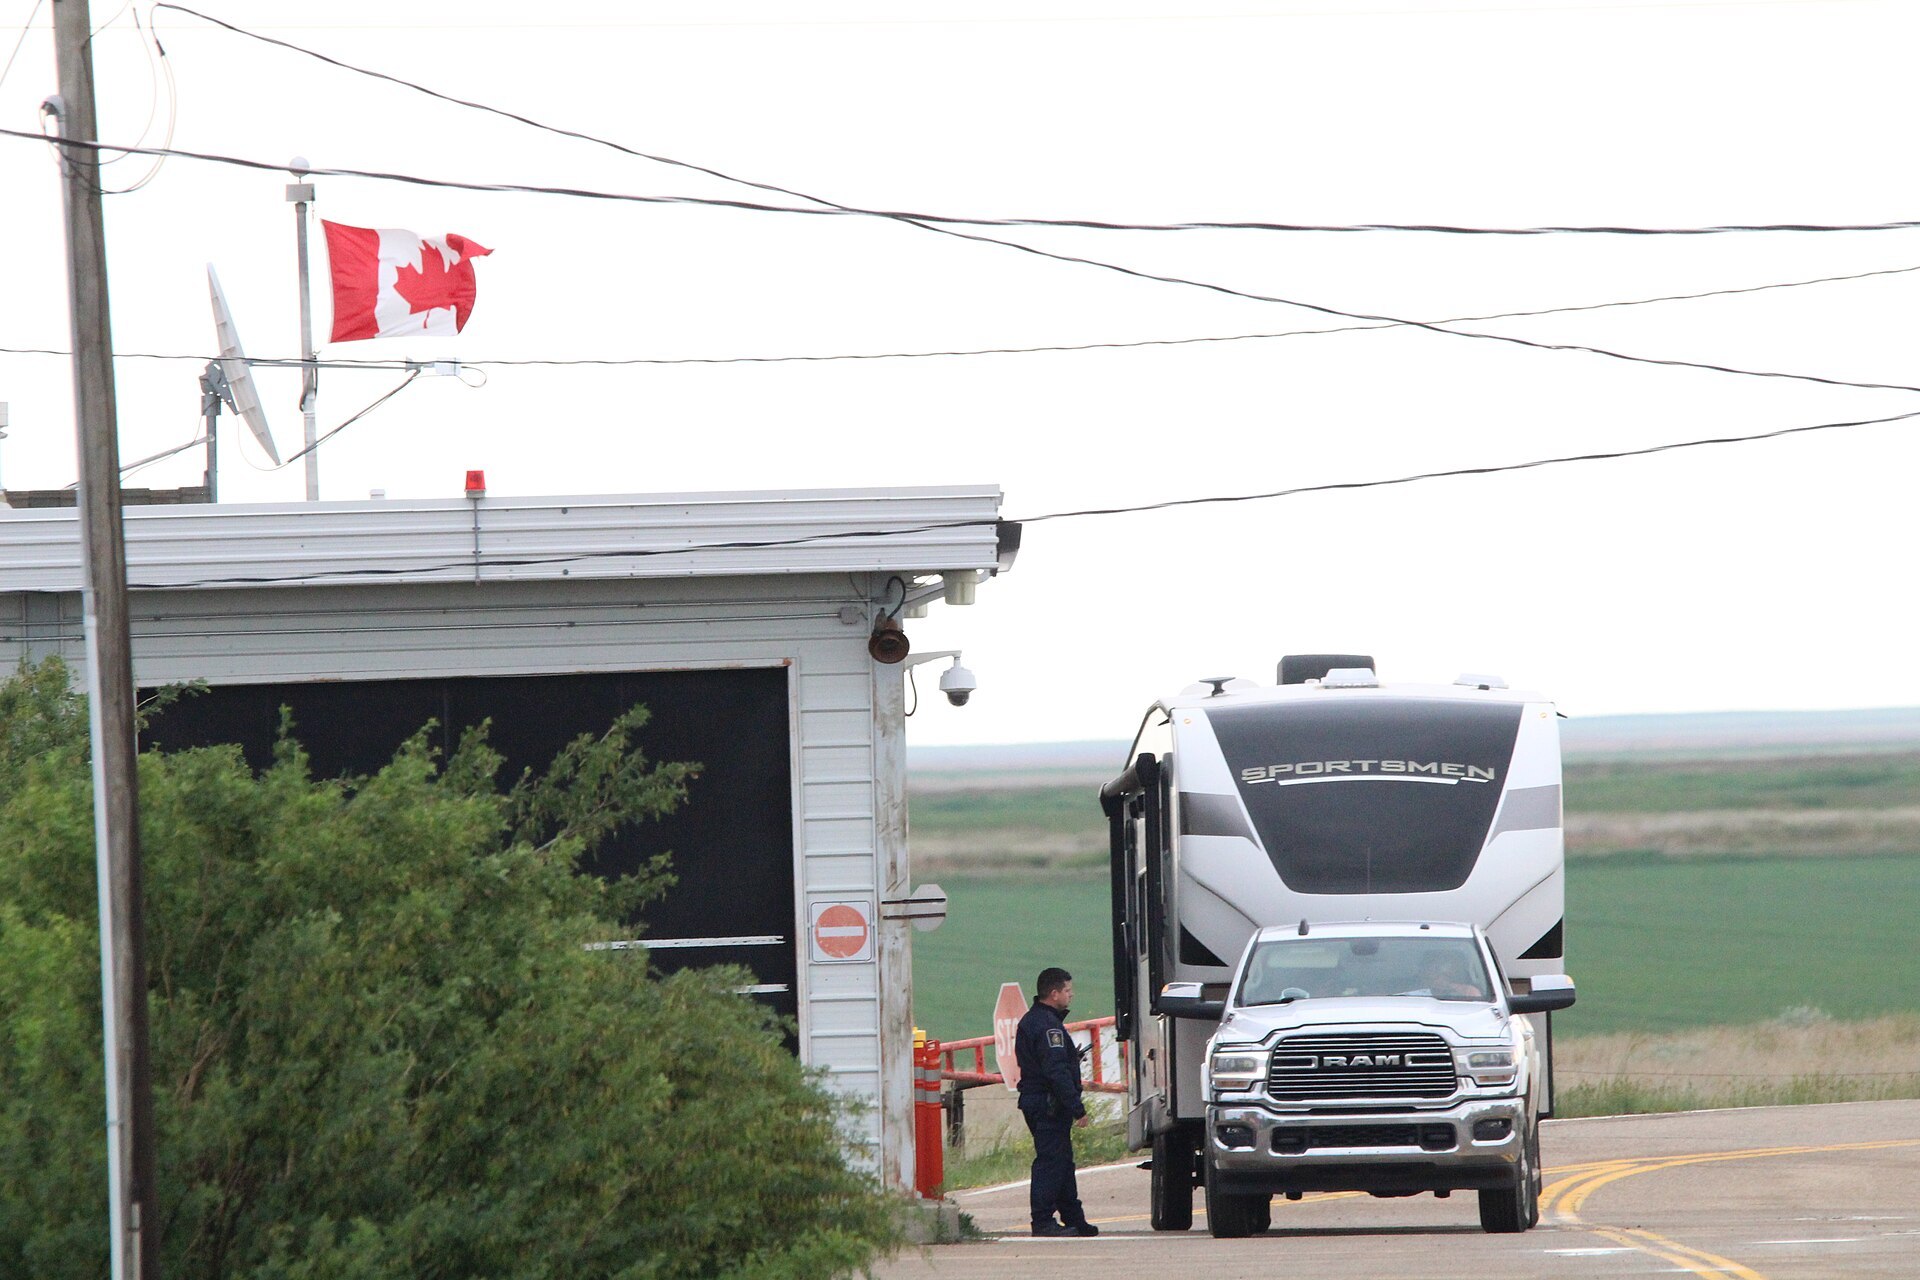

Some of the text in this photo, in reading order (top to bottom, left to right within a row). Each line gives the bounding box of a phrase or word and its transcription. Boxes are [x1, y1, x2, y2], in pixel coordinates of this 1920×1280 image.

[1241, 760, 1495, 780] SPORTSMEN
[997, 1018, 1020, 1056] ST
[1323, 1055, 1400, 1067] RAM
